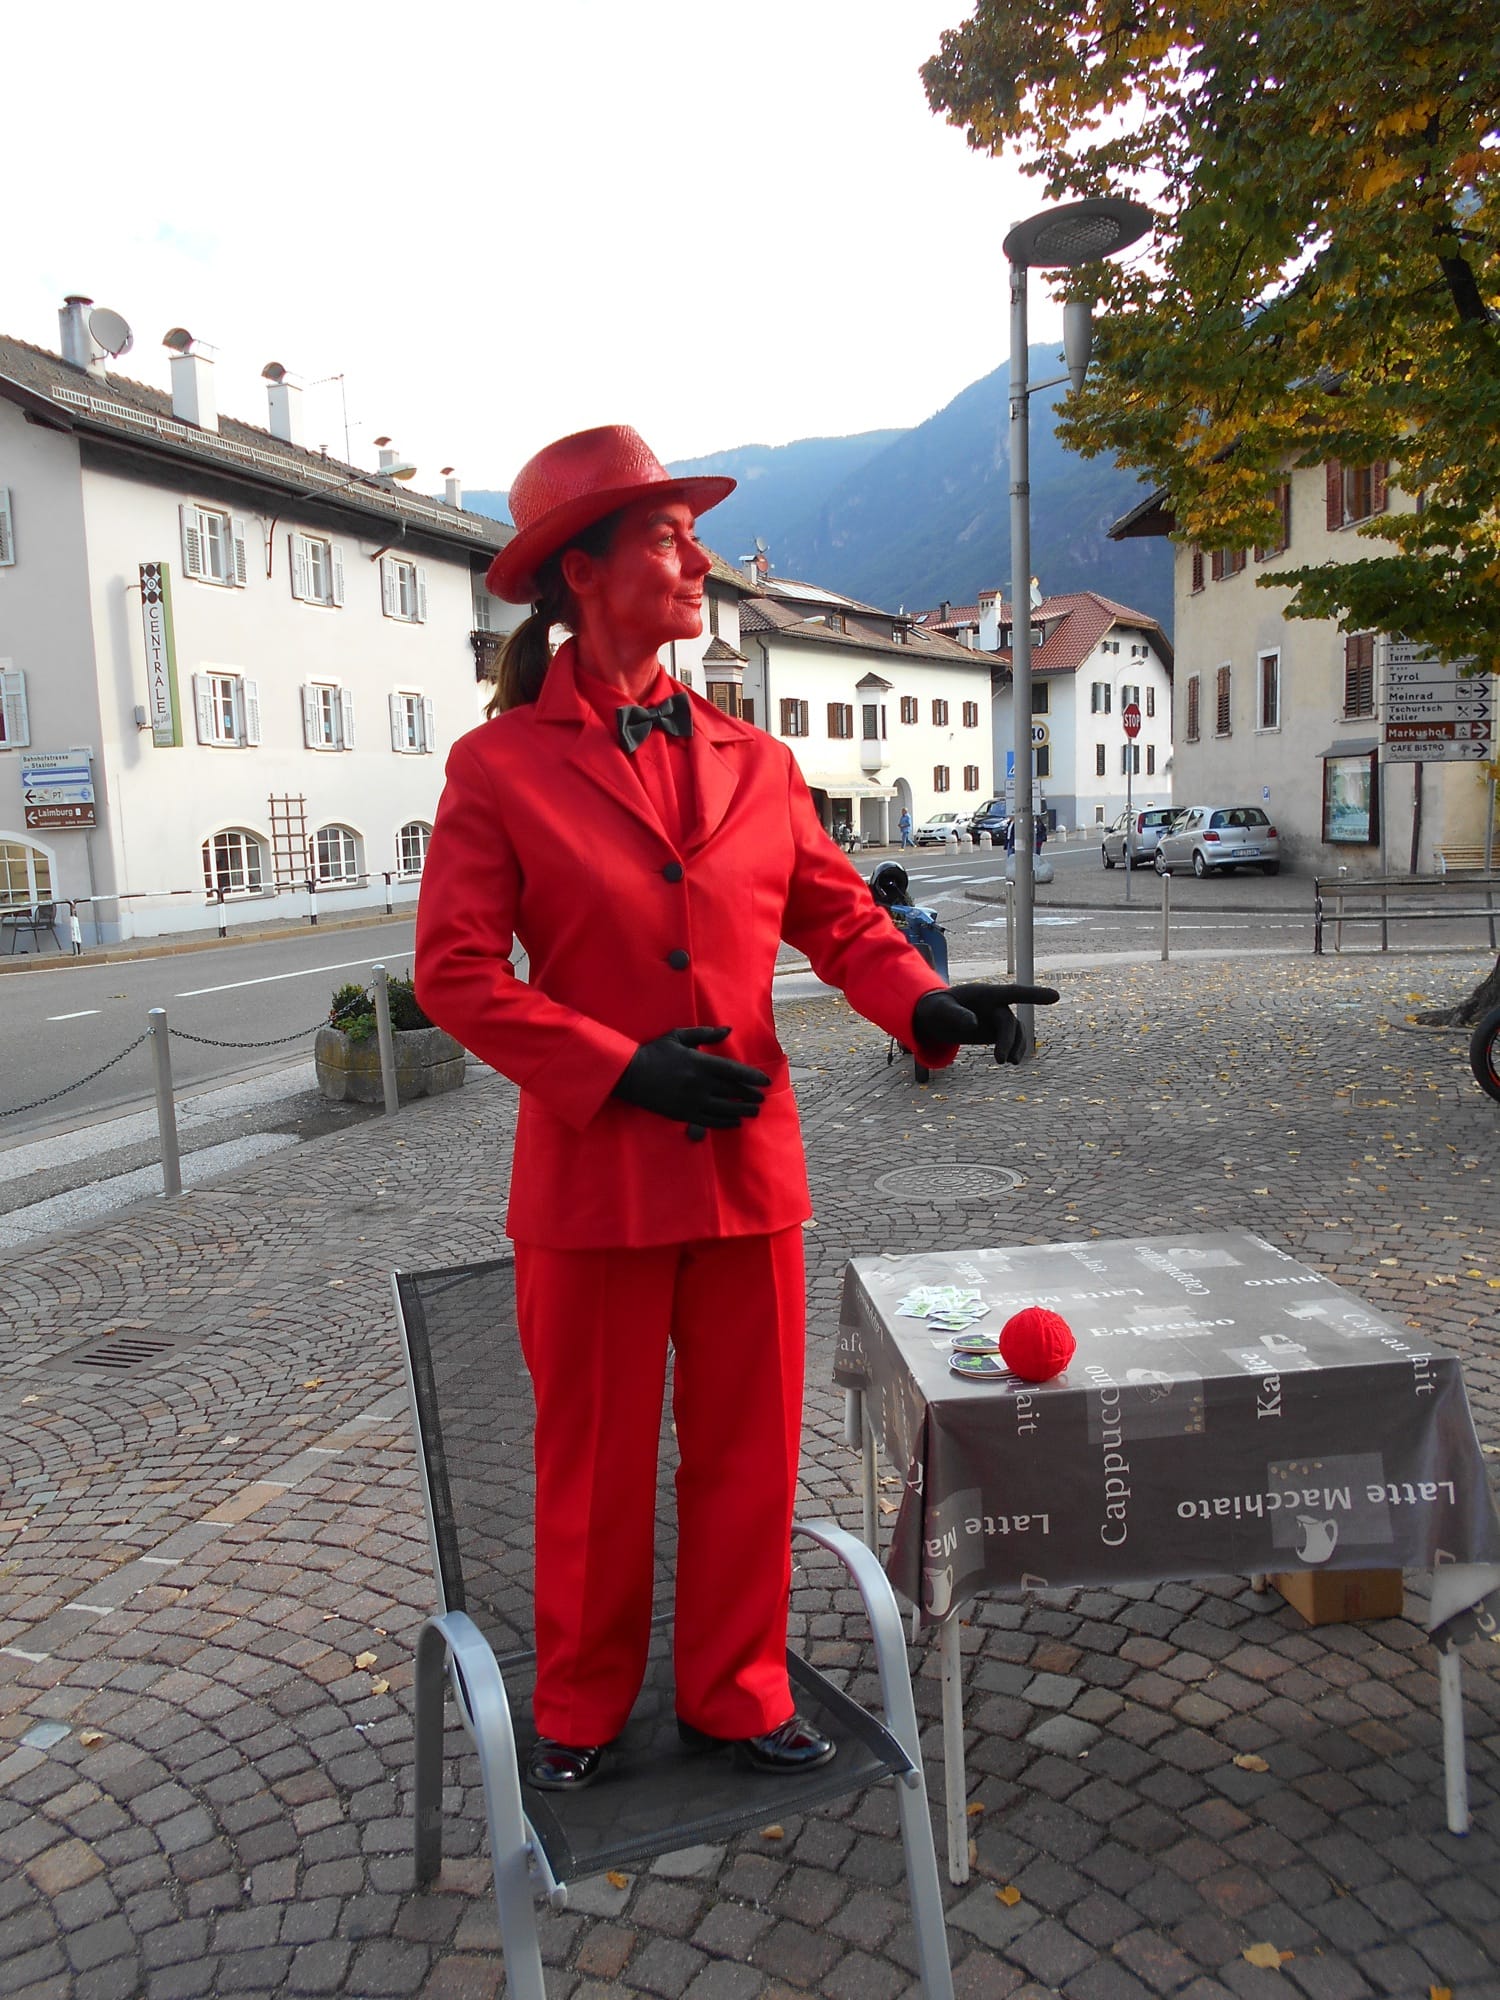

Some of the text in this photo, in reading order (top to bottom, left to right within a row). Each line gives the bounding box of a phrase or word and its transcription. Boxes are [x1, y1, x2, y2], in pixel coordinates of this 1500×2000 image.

[149, 607, 166, 713] CENTRALE
[1390, 673, 1419, 682] Tyrol
[1389, 692, 1433, 701] Meinrad
[1390, 705, 1443, 713] Tschurtsch
[1124, 714, 1140, 727] STOP
[1388, 727, 1447, 738] Markushof
[1414, 743, 1445, 752] BISTRO
[38, 808, 73, 817] Laimburg
[1071, 1288, 1145, 1300] Latte
[1089, 1318, 1235, 1337] Espresso
[1380, 1338, 1411, 1351] au
[1405, 1352, 1438, 1397] lait
[1014, 1388, 1041, 1437] lait
[1084, 1365, 1132, 1546] Cappuccino
[1177, 1481, 1456, 1519] Latte Macchiato
[964, 1513, 1050, 1535] Latte
